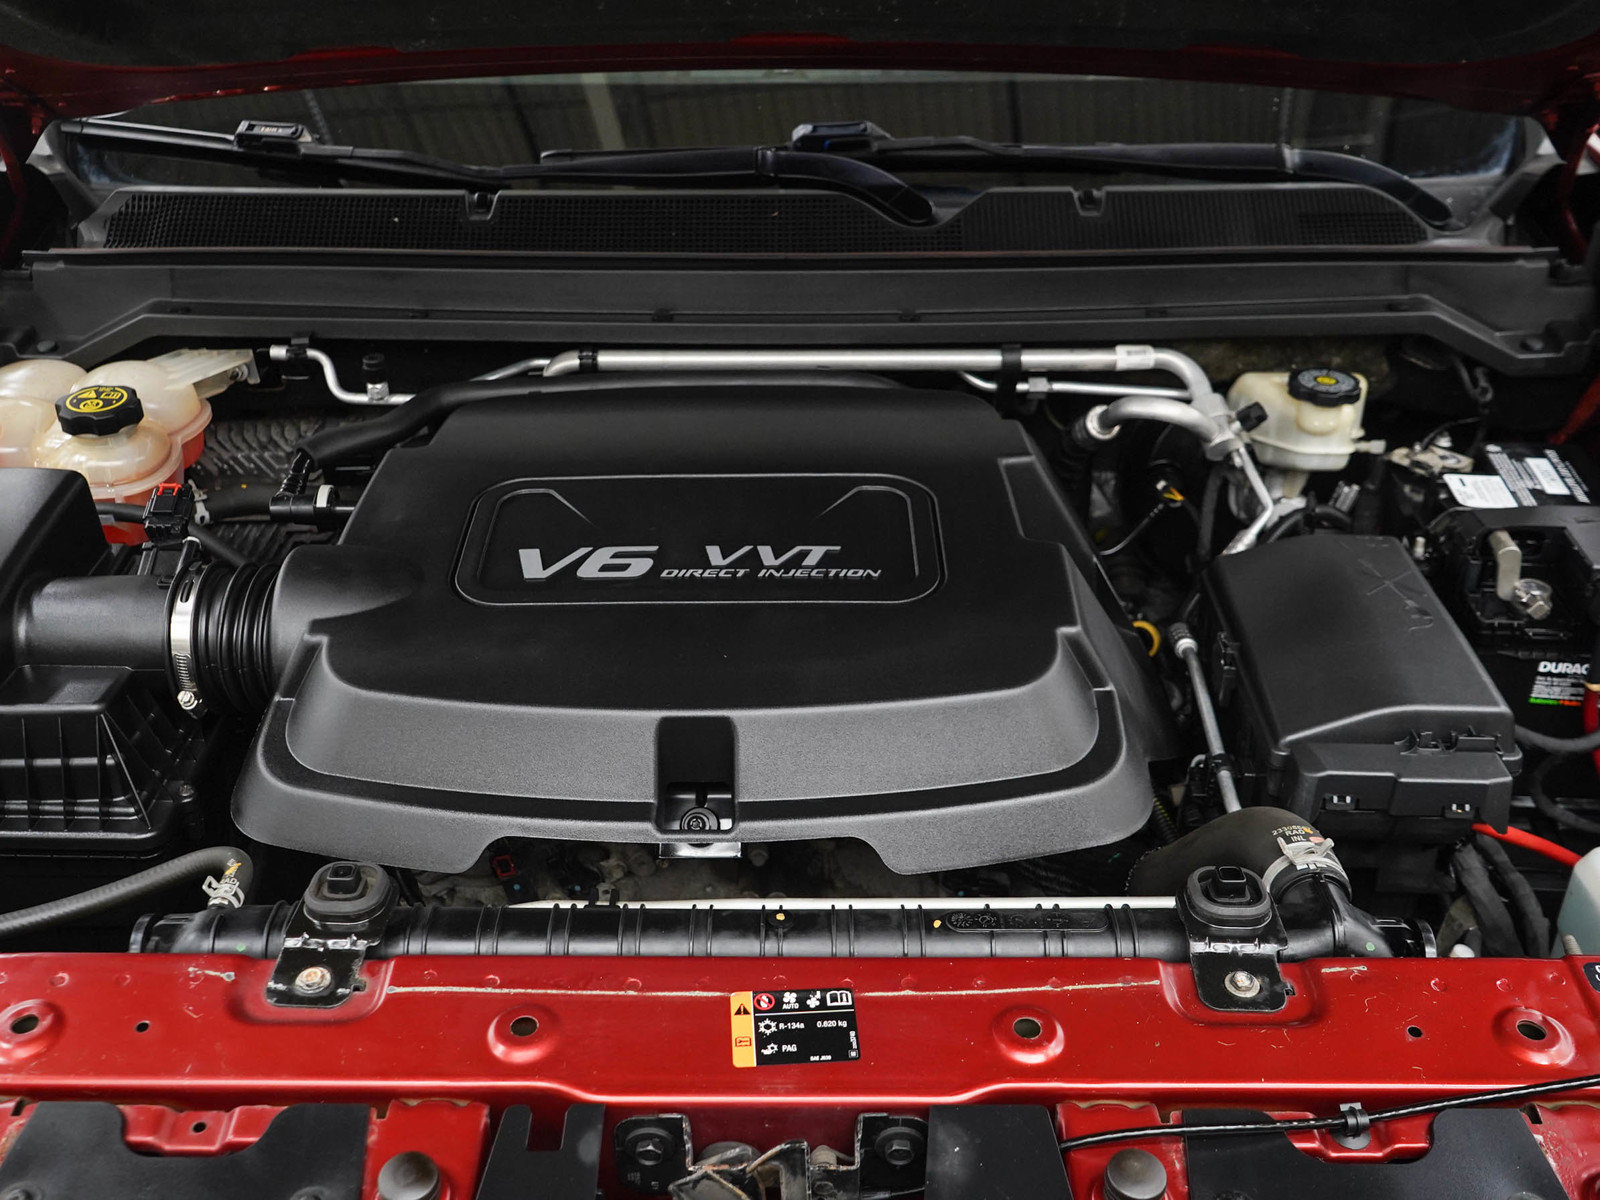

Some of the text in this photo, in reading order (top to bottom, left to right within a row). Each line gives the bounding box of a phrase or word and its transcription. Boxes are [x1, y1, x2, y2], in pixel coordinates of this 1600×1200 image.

[705, 545, 842, 566] VVT
[518, 545, 659, 580] V6
[660, 568, 881, 578] DIRECT INJECTION
[838, 1020, 847, 1028] kg
[782, 1044, 797, 1052] PAG
